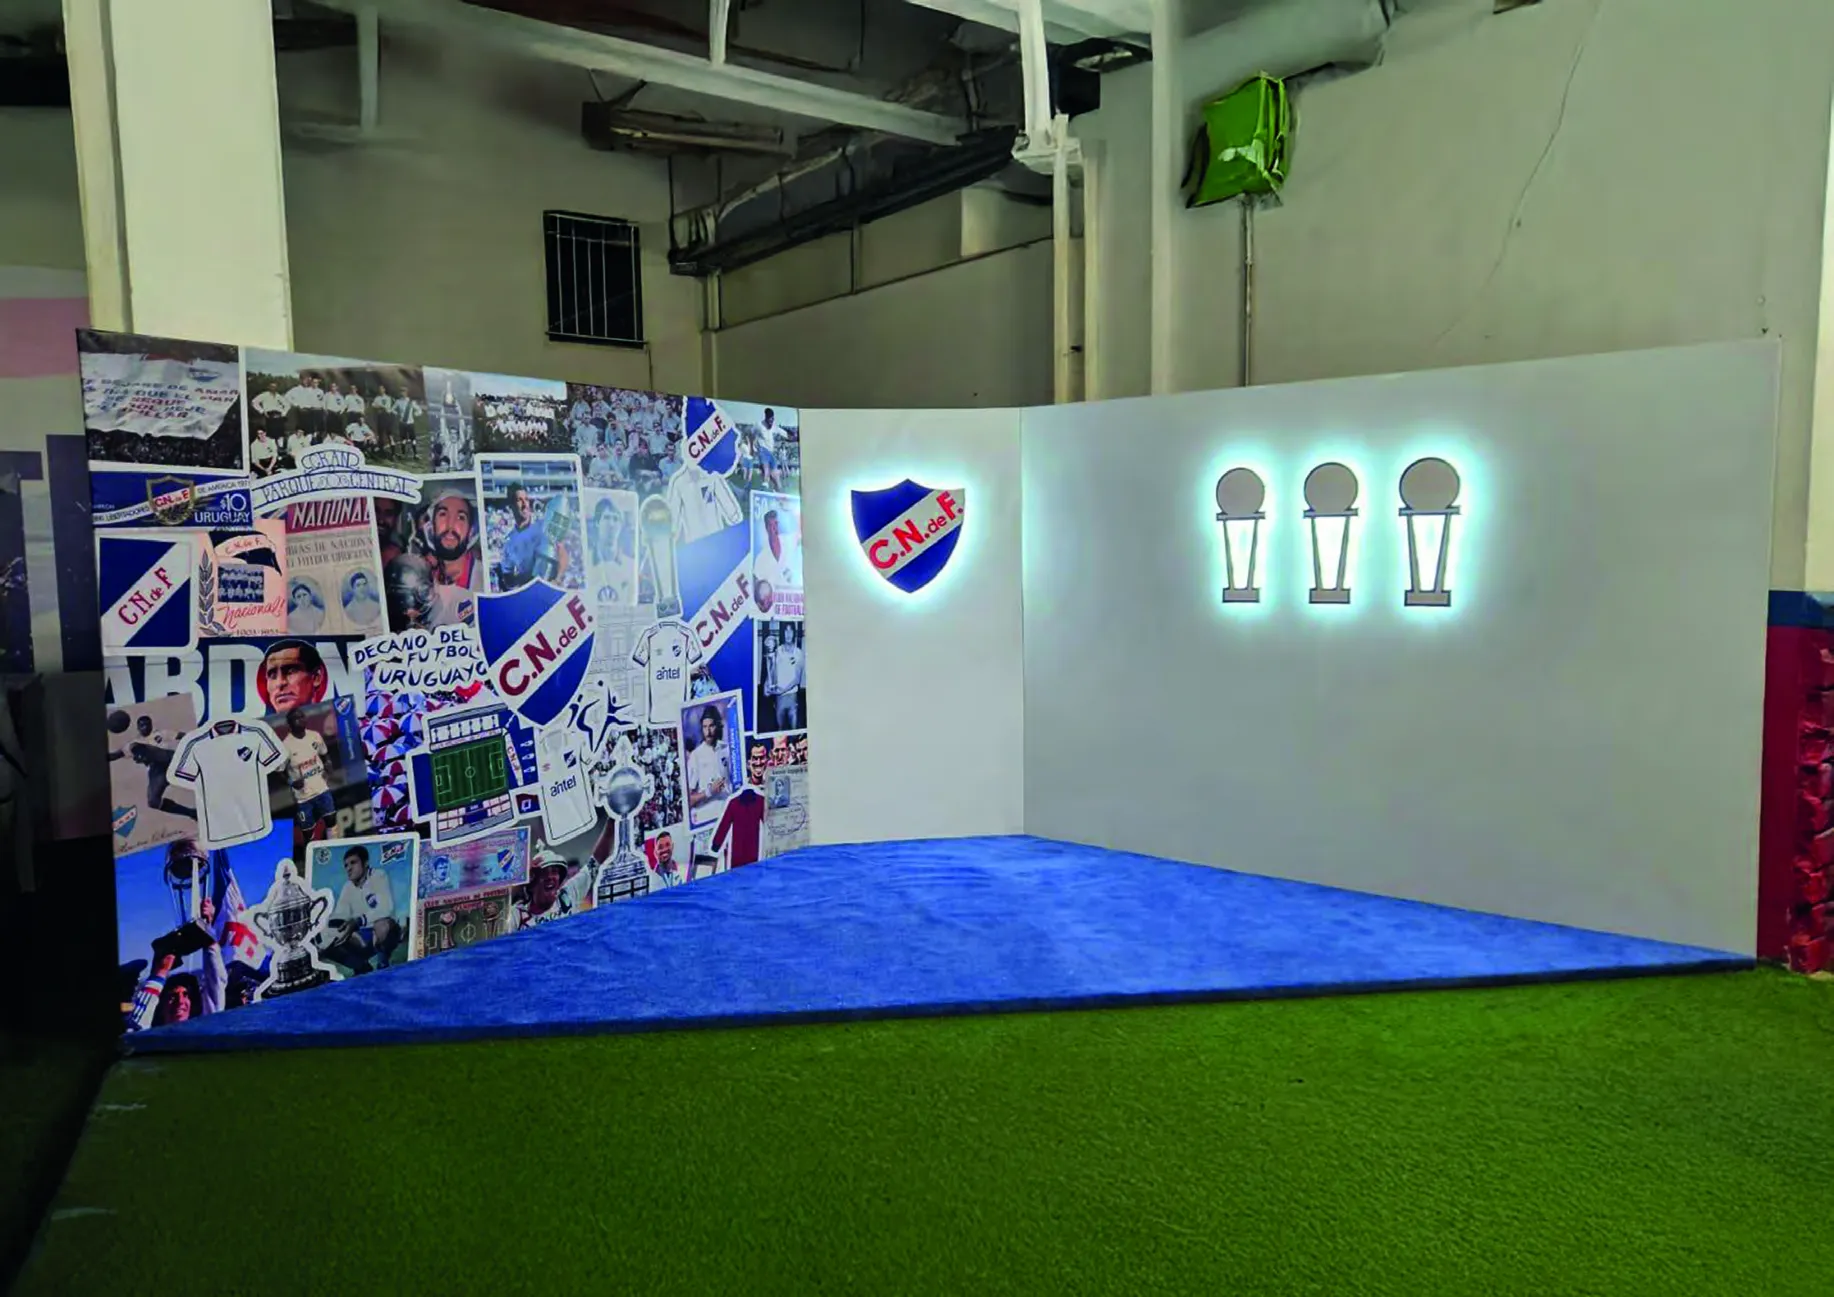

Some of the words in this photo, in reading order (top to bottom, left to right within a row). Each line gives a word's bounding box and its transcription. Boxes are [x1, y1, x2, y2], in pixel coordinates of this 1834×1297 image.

[262, 475, 315, 502] PARQUE
[351, 472, 411, 495] CENTRAL
[220, 493, 247, 512] $10
[195, 511, 250, 523] URUGUAY
[354, 634, 427, 665] DECANO
[440, 630, 473, 643] DEL
[406, 645, 478, 667] FUTBOL
[379, 661, 487, 687] URUGUAYO
[656, 666, 680, 681] antel
[550, 775, 577, 797] antel
